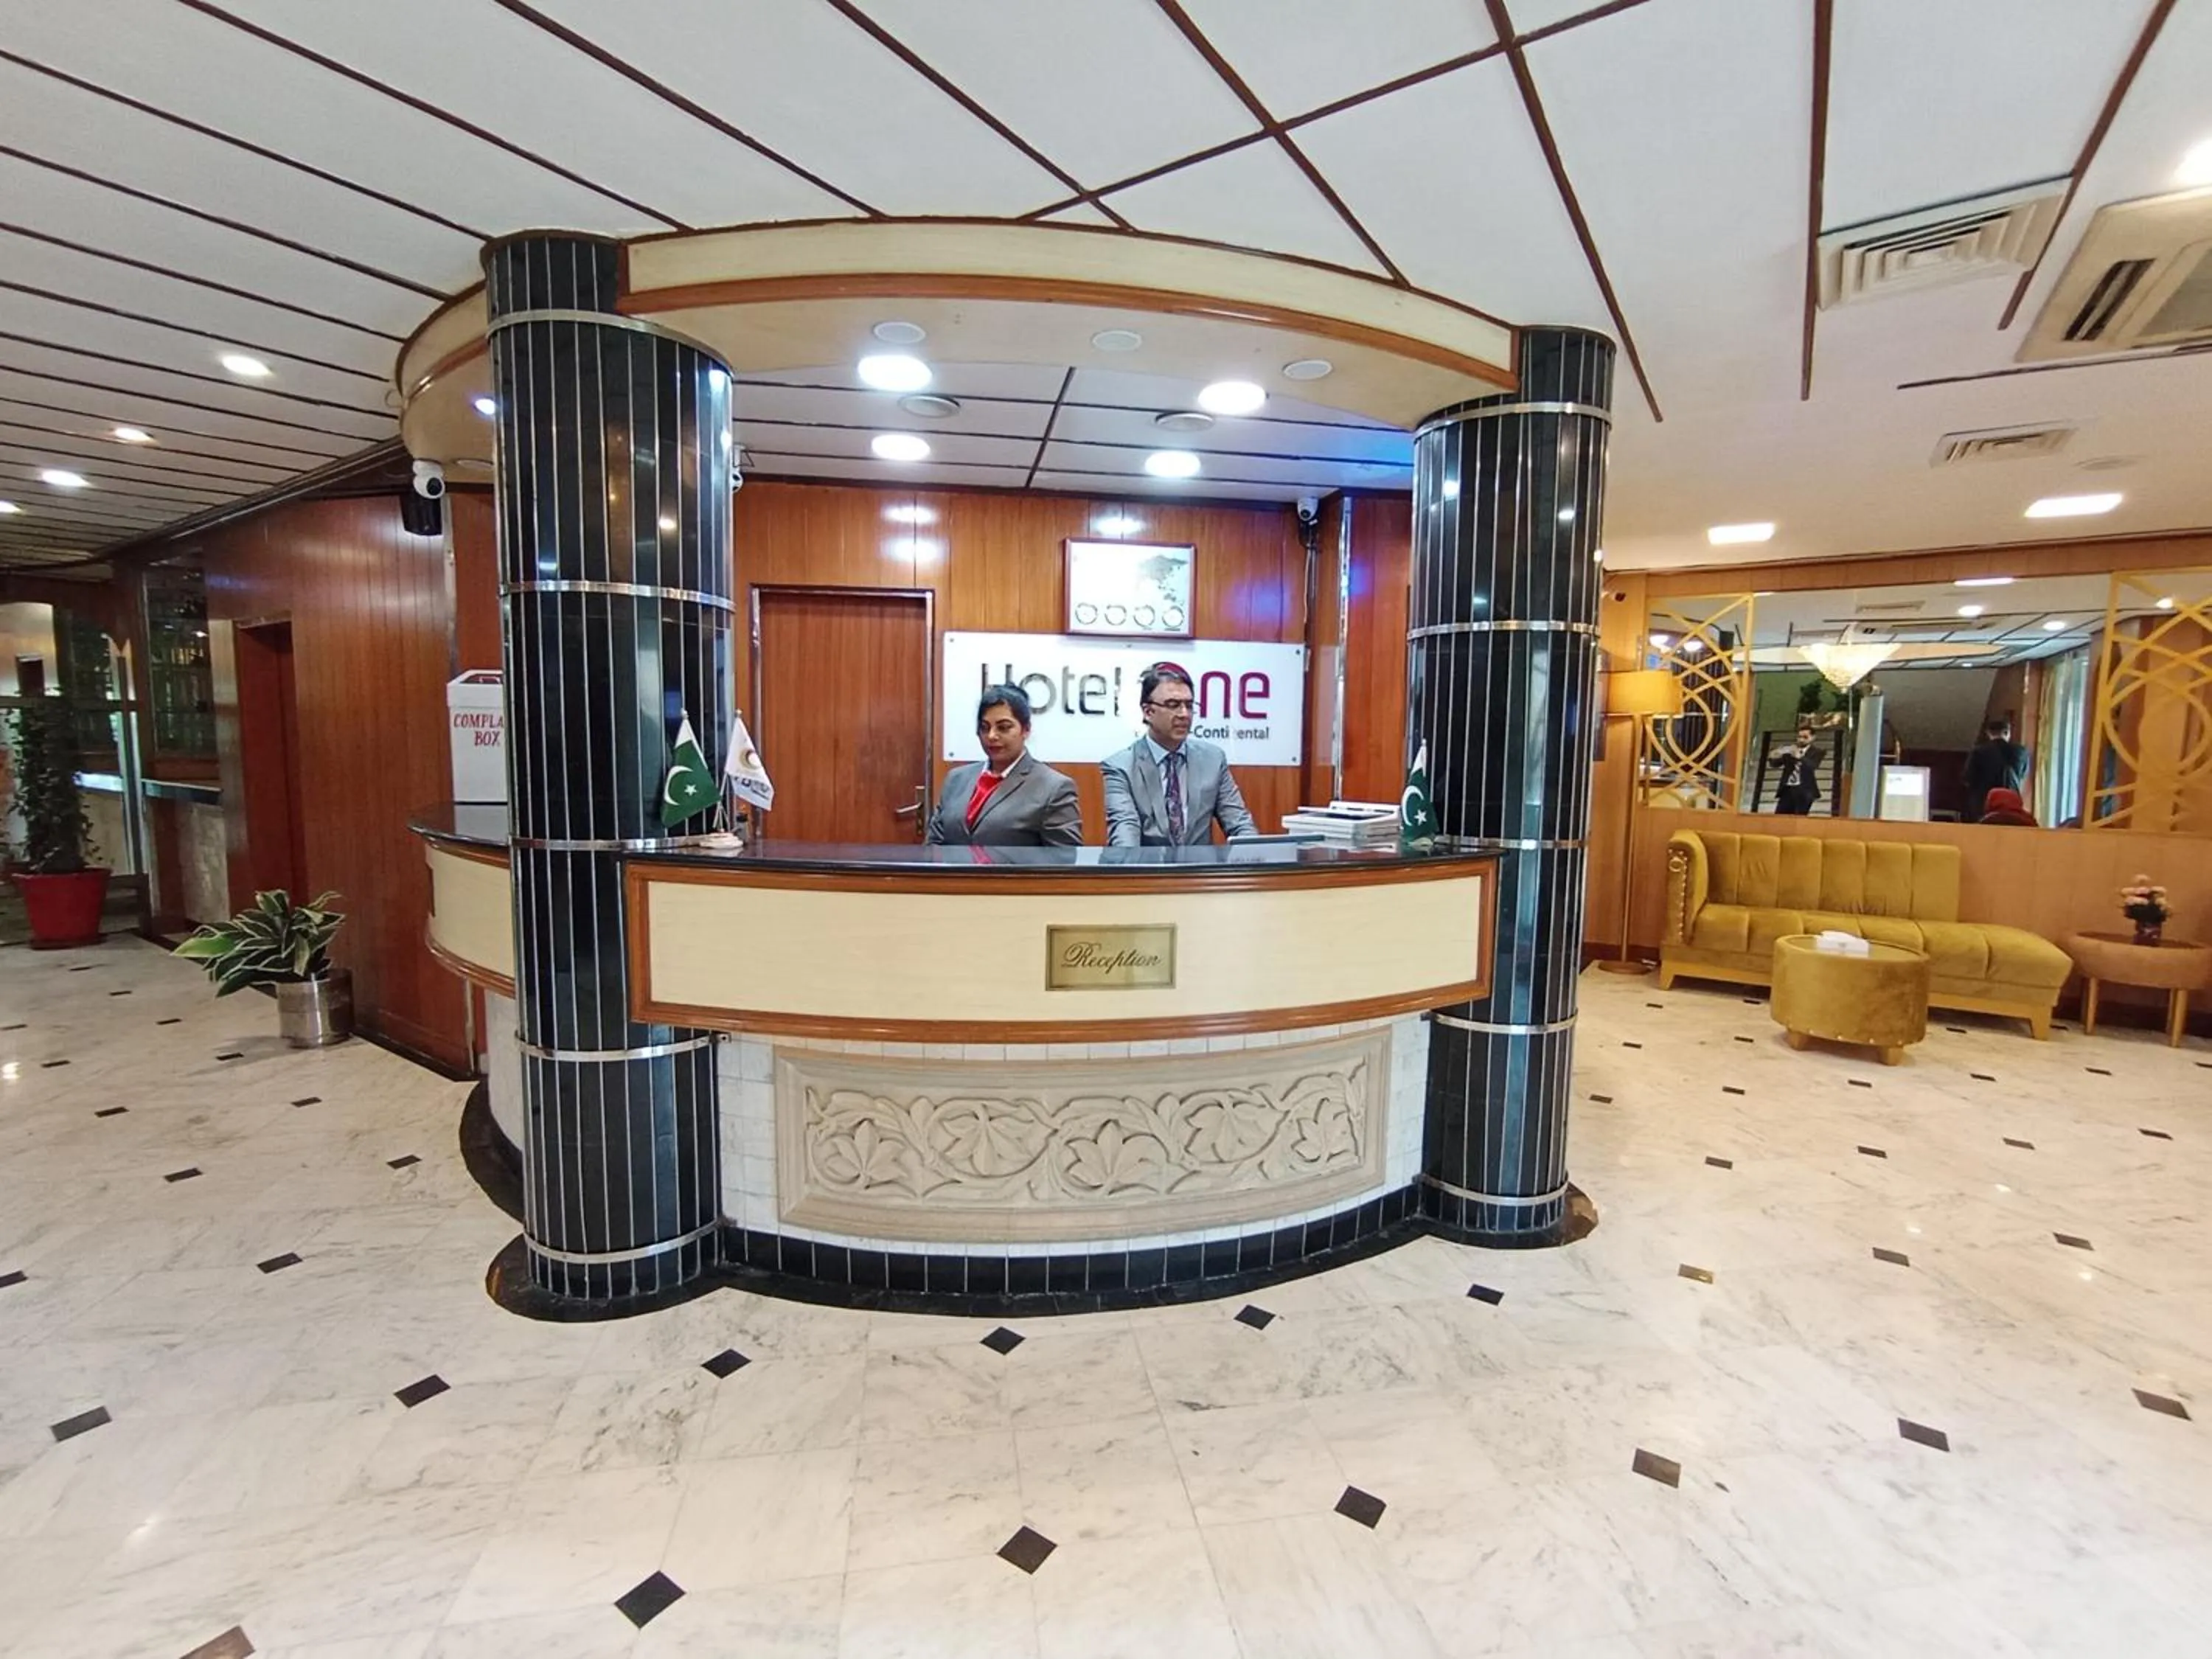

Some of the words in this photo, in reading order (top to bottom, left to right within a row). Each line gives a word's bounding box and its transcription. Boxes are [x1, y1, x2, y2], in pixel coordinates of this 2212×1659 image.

[1158, 662, 1270, 720] ne
[453, 714, 504, 729] COMPLA
[474, 731, 501, 747] BOX
[1061, 942, 1161, 975] Reception
